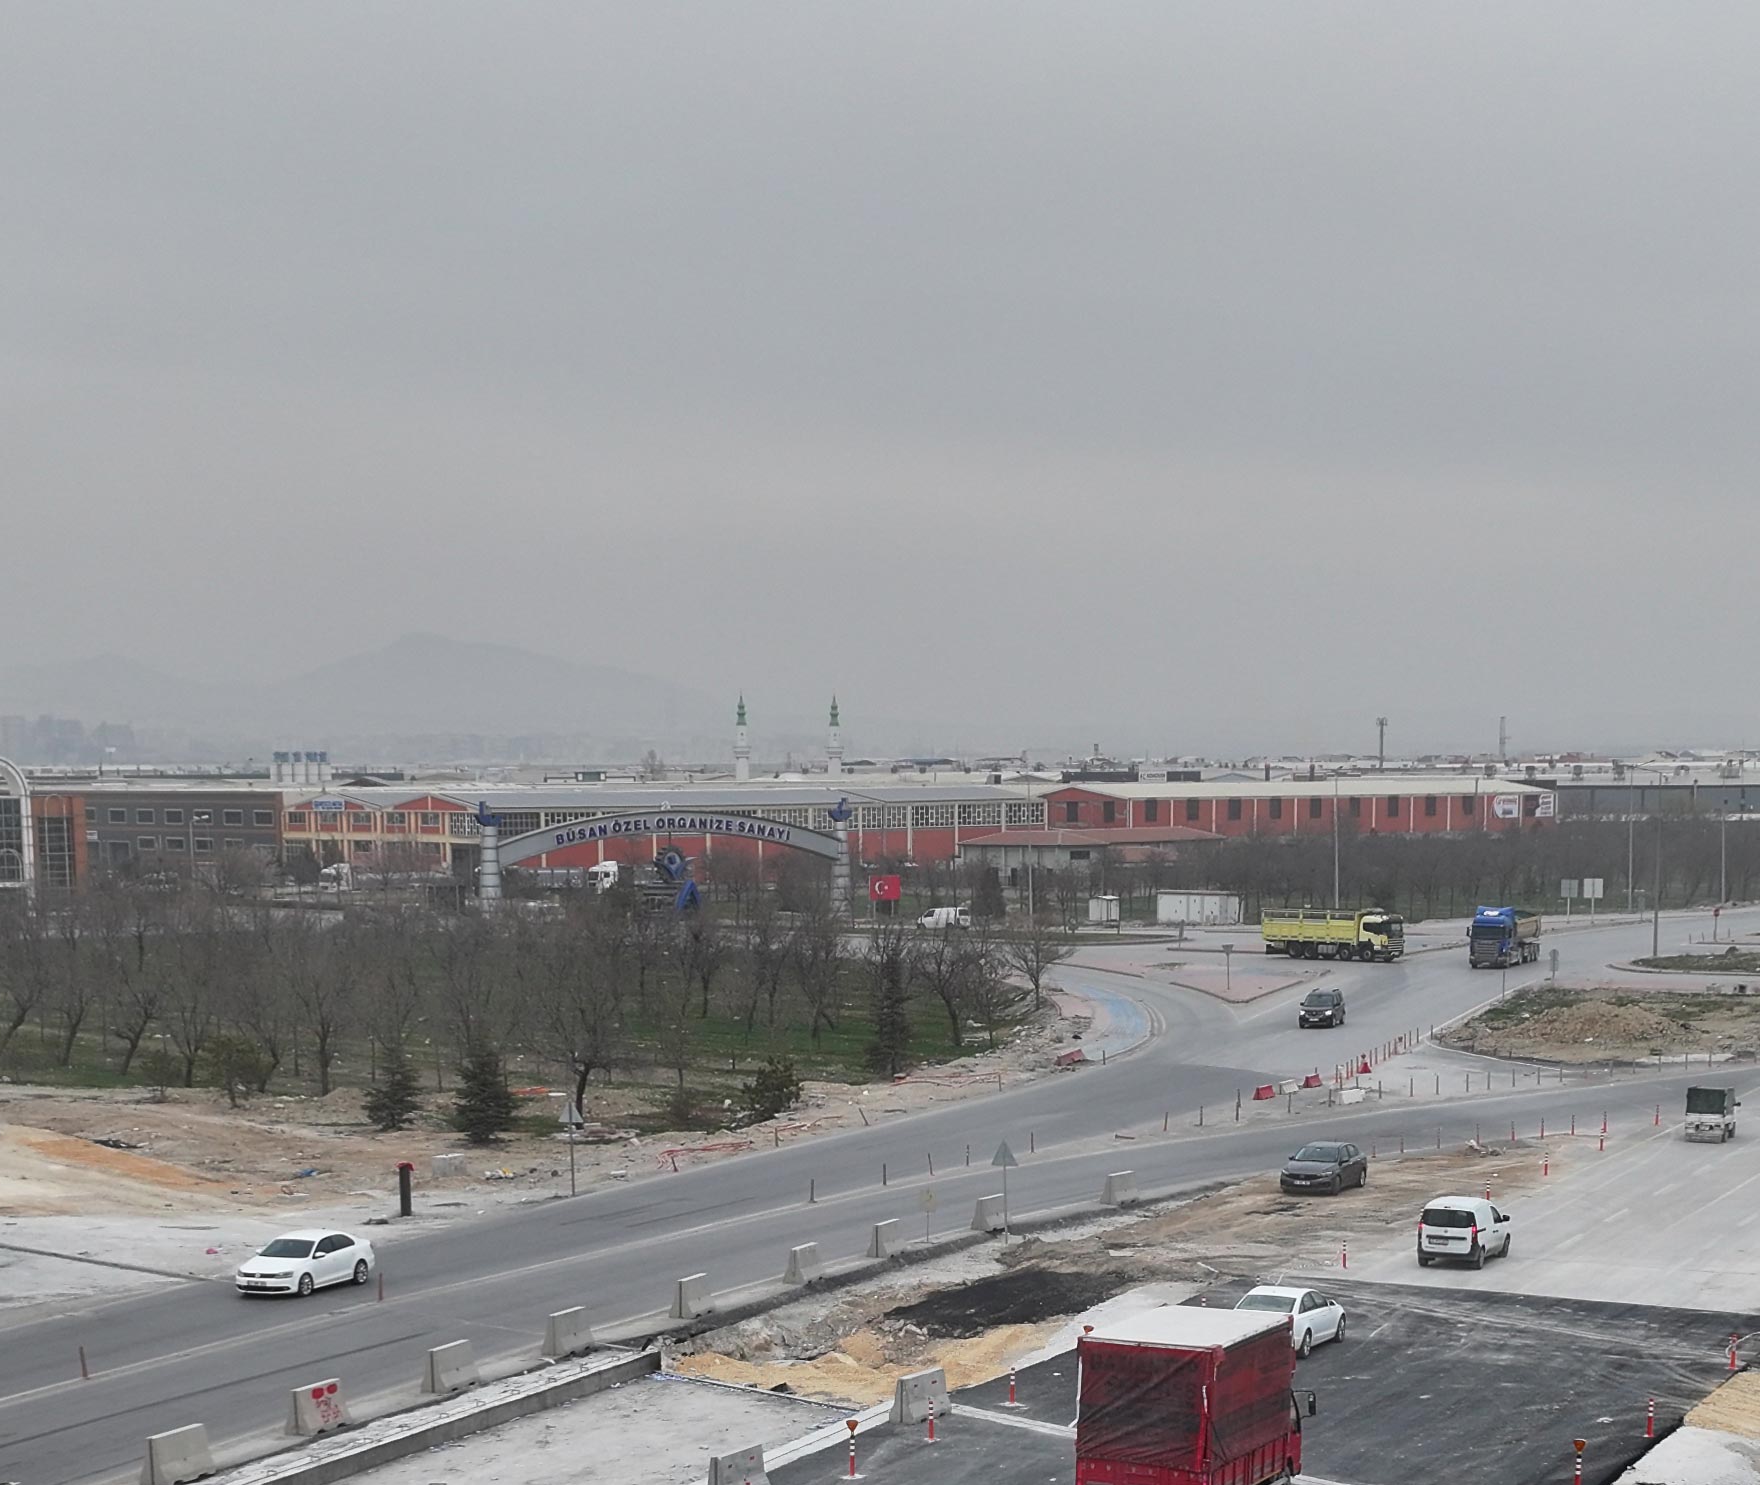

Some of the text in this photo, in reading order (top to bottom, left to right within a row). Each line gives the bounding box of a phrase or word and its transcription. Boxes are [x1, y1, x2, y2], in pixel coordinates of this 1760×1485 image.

[555, 815, 790, 845] BÜSAN ÖZEL ORGANİZE SANAYİ
